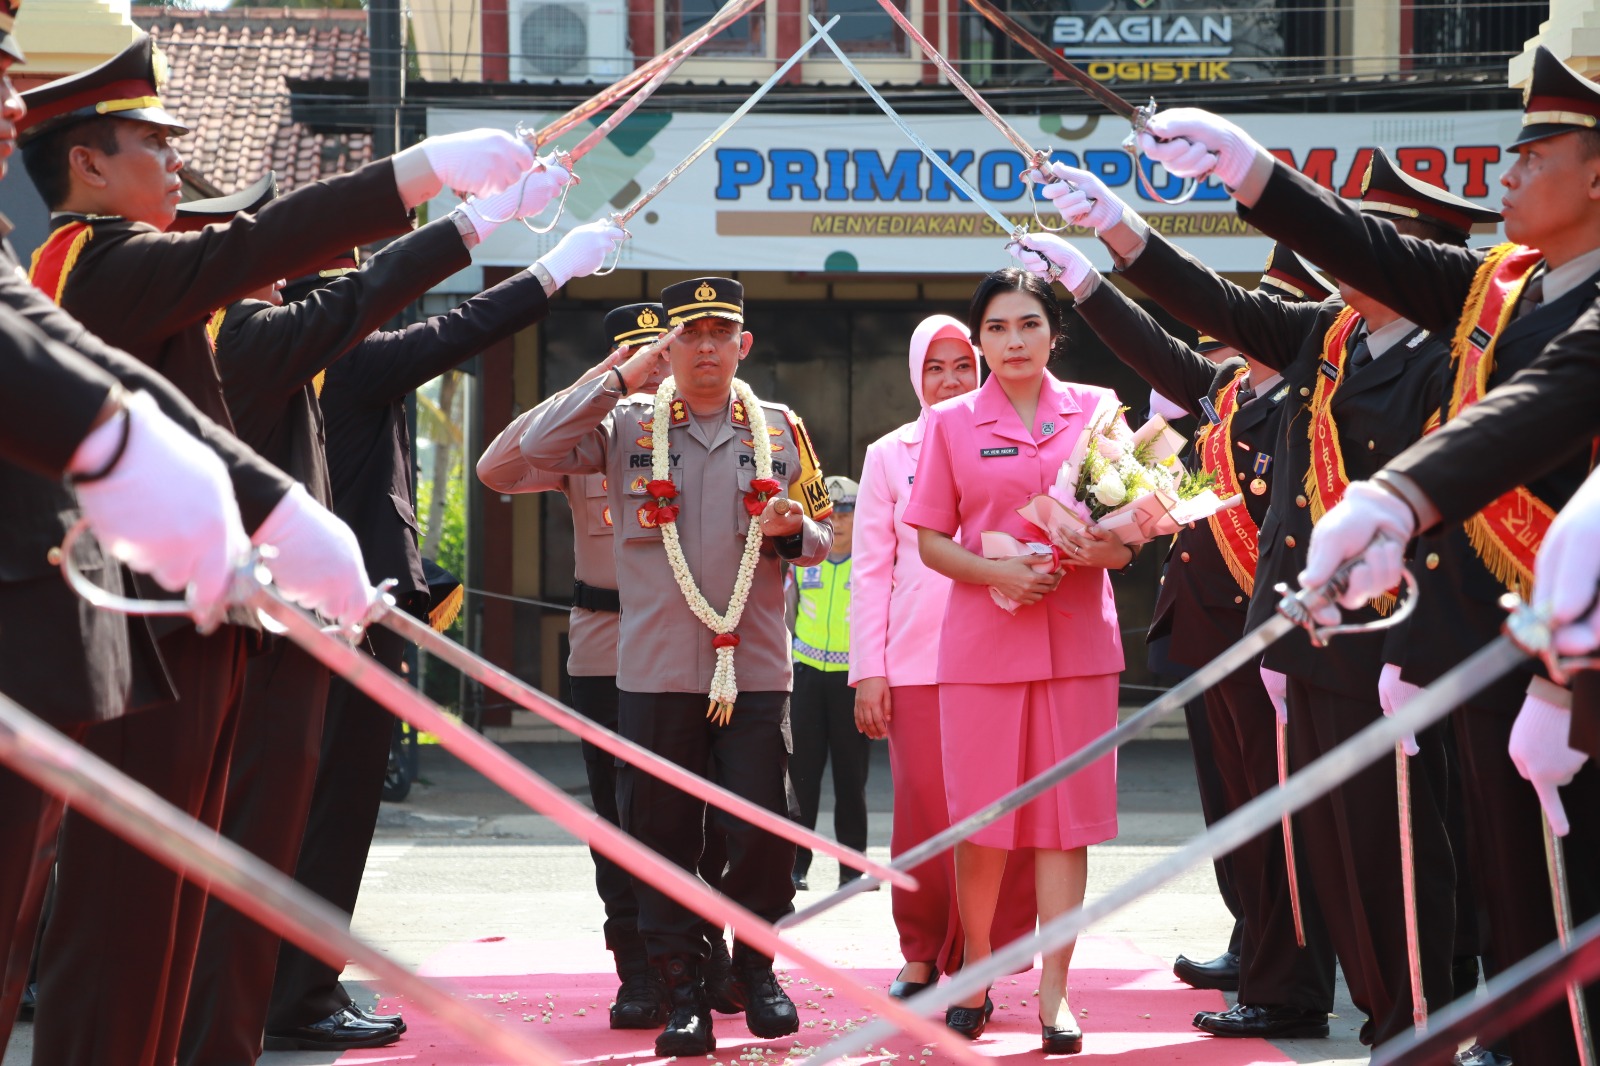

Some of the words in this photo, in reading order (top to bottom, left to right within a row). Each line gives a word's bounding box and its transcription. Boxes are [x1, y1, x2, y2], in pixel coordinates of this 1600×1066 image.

[1053, 16, 1233, 43] BAGIAN
[1087, 61, 1231, 81] OGISTIK
[811, 215, 974, 234] MENYEDIAKAN
